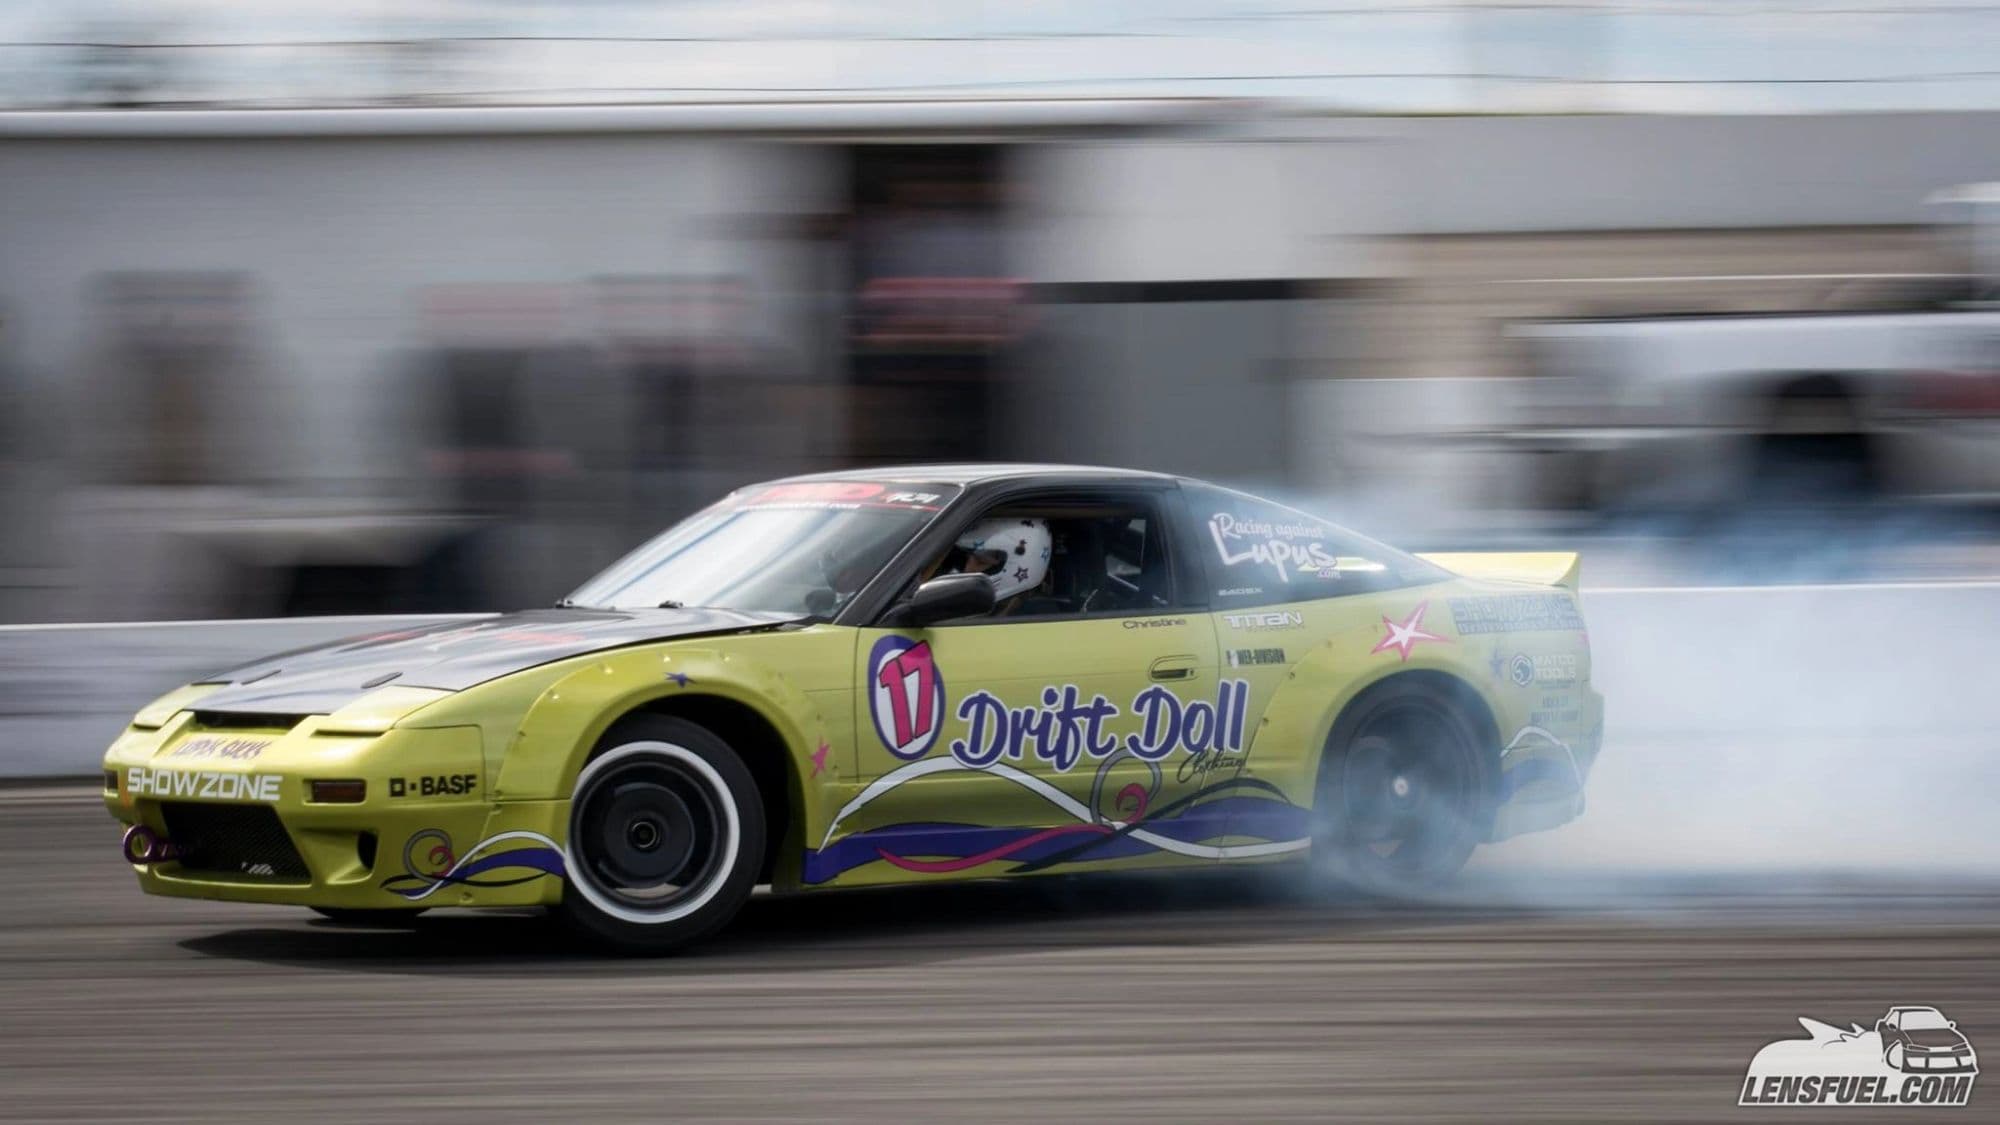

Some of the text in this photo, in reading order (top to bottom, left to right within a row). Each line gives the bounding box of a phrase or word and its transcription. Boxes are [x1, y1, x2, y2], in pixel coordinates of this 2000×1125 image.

[1213, 512, 1325, 540] Racing against
[1208, 520, 1338, 583] Lupus
[1122, 618, 1187, 630] Christine
[878, 639, 934, 749] 17
[951, 679, 1250, 772] Drift Doll
[127, 767, 283, 800] SHOWZONE
[420, 775, 478, 796] BASF
